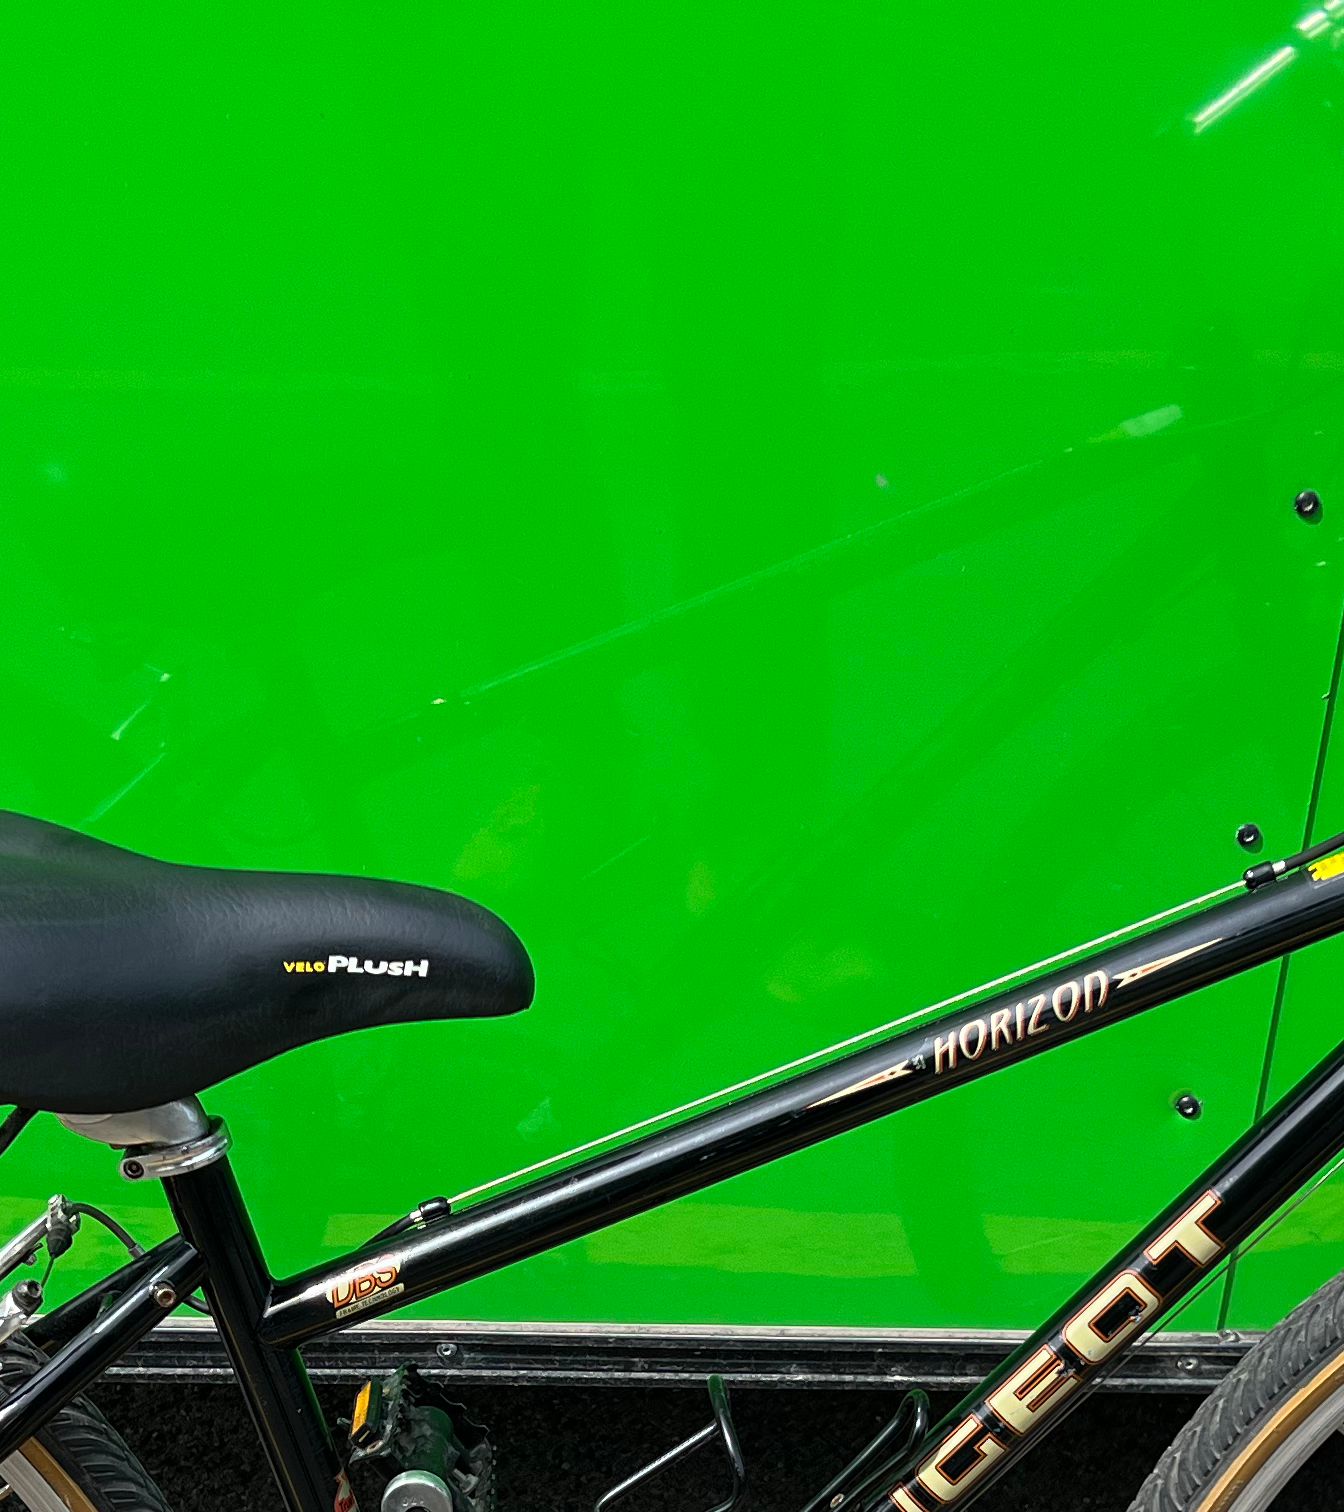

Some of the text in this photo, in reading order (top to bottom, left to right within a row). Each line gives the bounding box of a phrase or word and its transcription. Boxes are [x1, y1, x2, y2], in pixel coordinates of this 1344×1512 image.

[283, 955, 429, 977] VELO PLUSH
[934, 969, 1110, 1075] HORIZON
